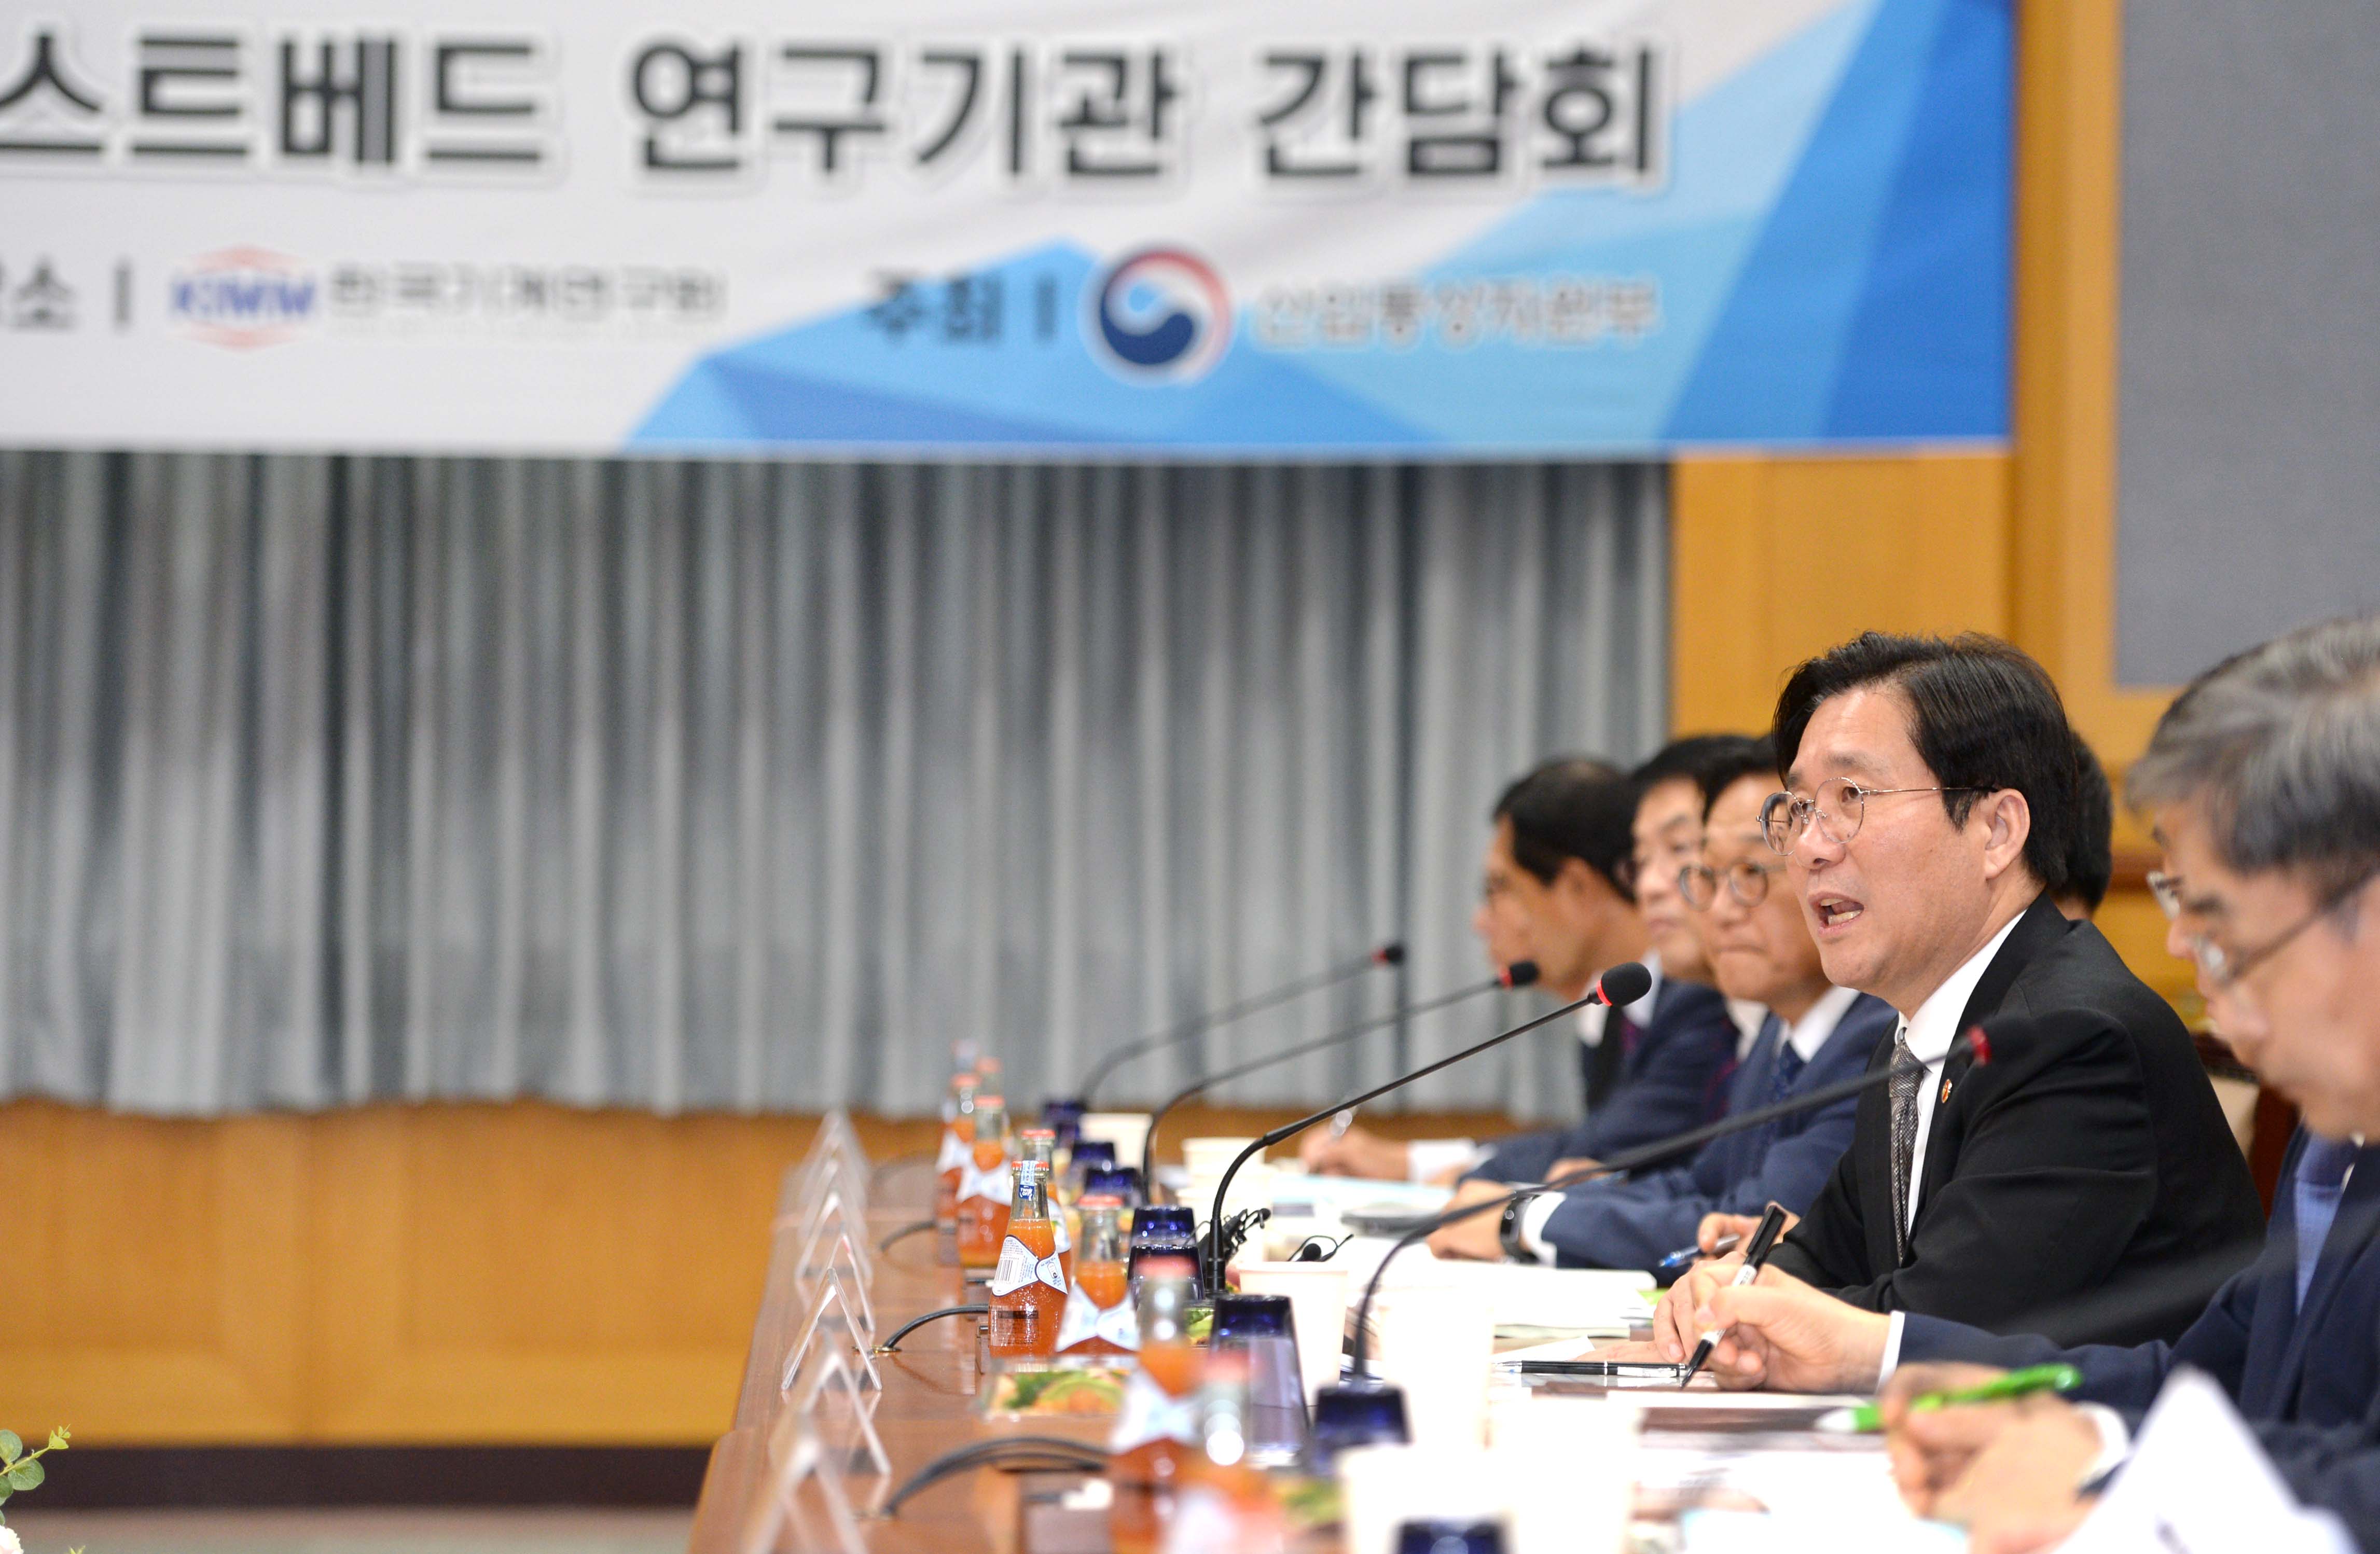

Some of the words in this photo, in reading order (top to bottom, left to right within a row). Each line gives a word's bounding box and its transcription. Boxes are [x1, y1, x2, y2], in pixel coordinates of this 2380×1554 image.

[0, 31, 542, 165] 스트베드
[631, 39, 1181, 177] 연구기관
[1257, 43, 1656, 179] 간담회
[0, 256, 77, 332] 소
